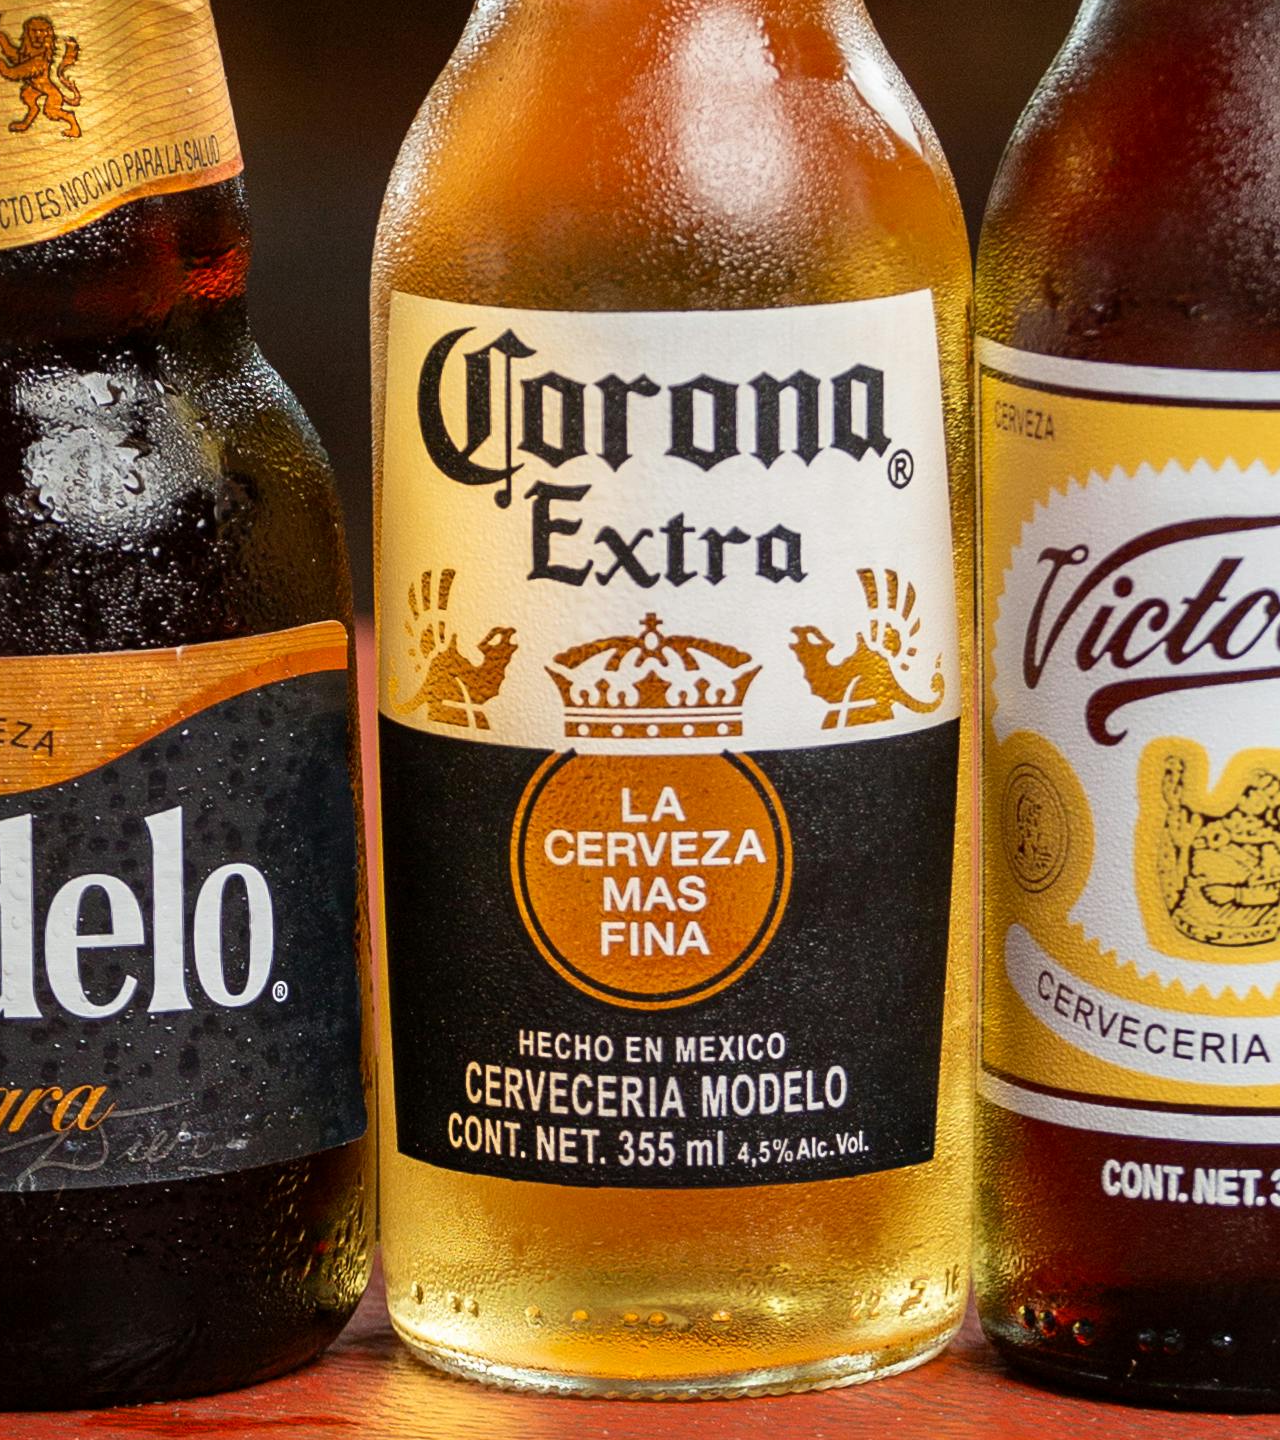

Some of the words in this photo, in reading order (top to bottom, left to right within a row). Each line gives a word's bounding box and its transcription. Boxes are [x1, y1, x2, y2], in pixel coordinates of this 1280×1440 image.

[35, 187, 62, 220] ES
[60, 158, 124, 212] NOCIVO
[123, 147, 166, 183] PARA
[165, 144, 184, 174] LA
[183, 134, 220, 171] SALUD
[417, 326, 892, 509] Corona
[994, 401, 1055, 440] CERVEZA
[524, 481, 808, 588] Extra
[620, 787, 686, 822] LA
[543, 829, 767, 867] CERVEZA
[602, 876, 708, 913] MAS
[600, 921, 711, 957] FINA
[1038, 970, 1270, 1065] CERVECERIA
[519, 1029, 614, 1063] HECHO
[625, 1037, 664, 1063] EN
[675, 1032, 786, 1063] MEXICO
[465, 1061, 686, 1117] CERVECERIA
[702, 1065, 848, 1118] MODELO
[448, 1112, 527, 1159] CONT.
[536, 1125, 607, 1165] NET.
[619, 1131, 676, 1167] 355
[686, 1131, 724, 1167] ml
[737, 1140, 794, 1170] 4,5%
[1101, 1159, 1189, 1203] CONT.
[1192, 1168, 1267, 1206] NET.
